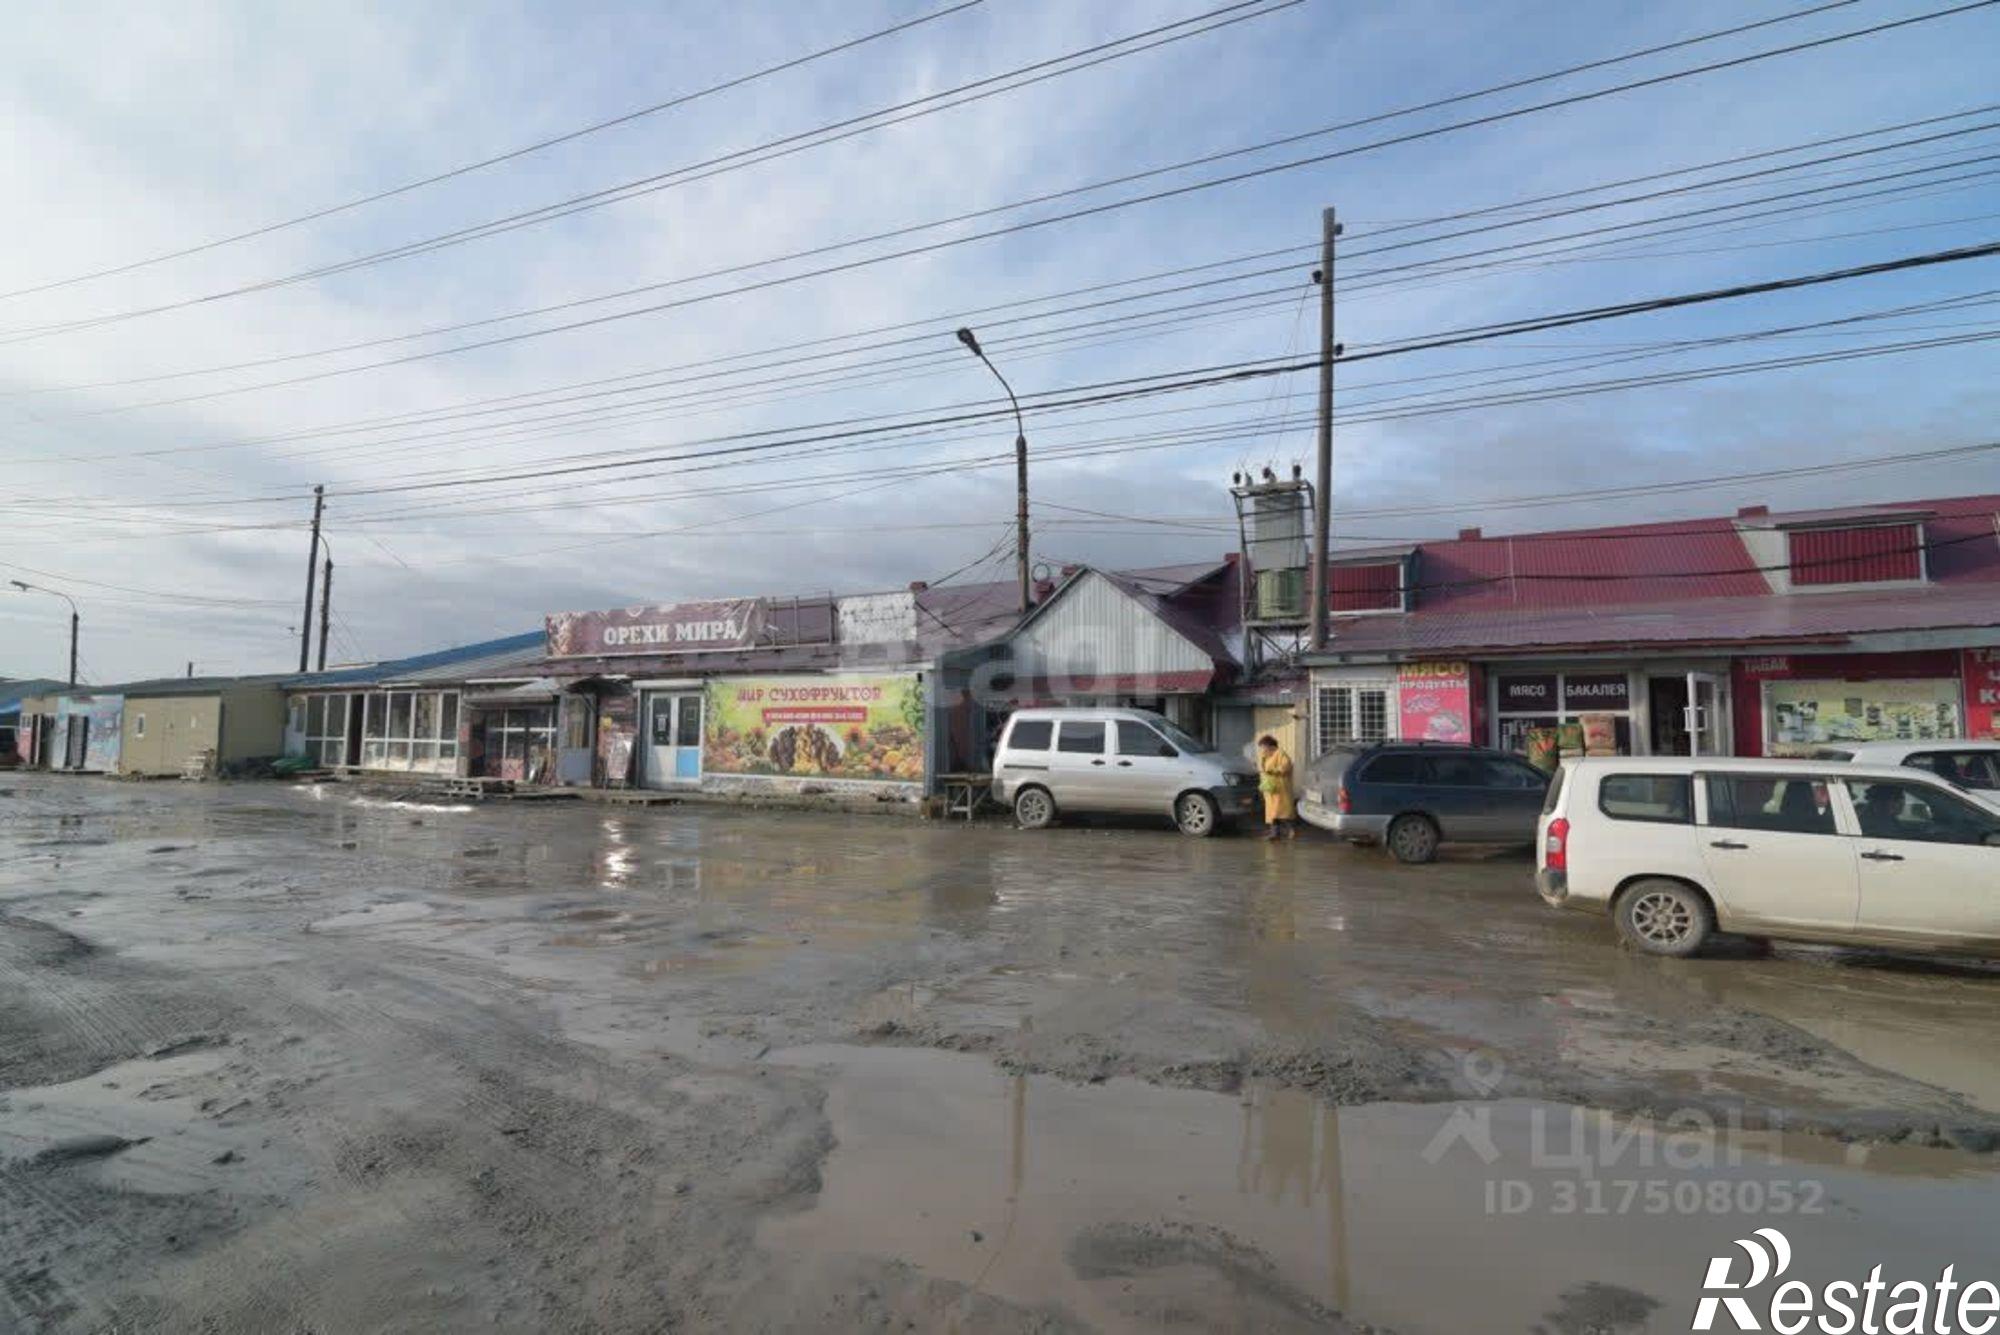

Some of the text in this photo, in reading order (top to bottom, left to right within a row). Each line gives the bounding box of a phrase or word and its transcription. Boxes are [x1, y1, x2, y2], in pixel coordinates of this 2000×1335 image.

[603, 619, 740, 646] ОРЕХИ МИРА
[1401, 661, 1466, 677] МЯСО
[1400, 680, 1469, 691] ПРОДУКТЫ
[1510, 684, 1546, 697] МЯСО
[1566, 683, 1626, 697] БАКАЛЕЯ
[768, 686, 882, 702] СУХОФРУКТОВ
